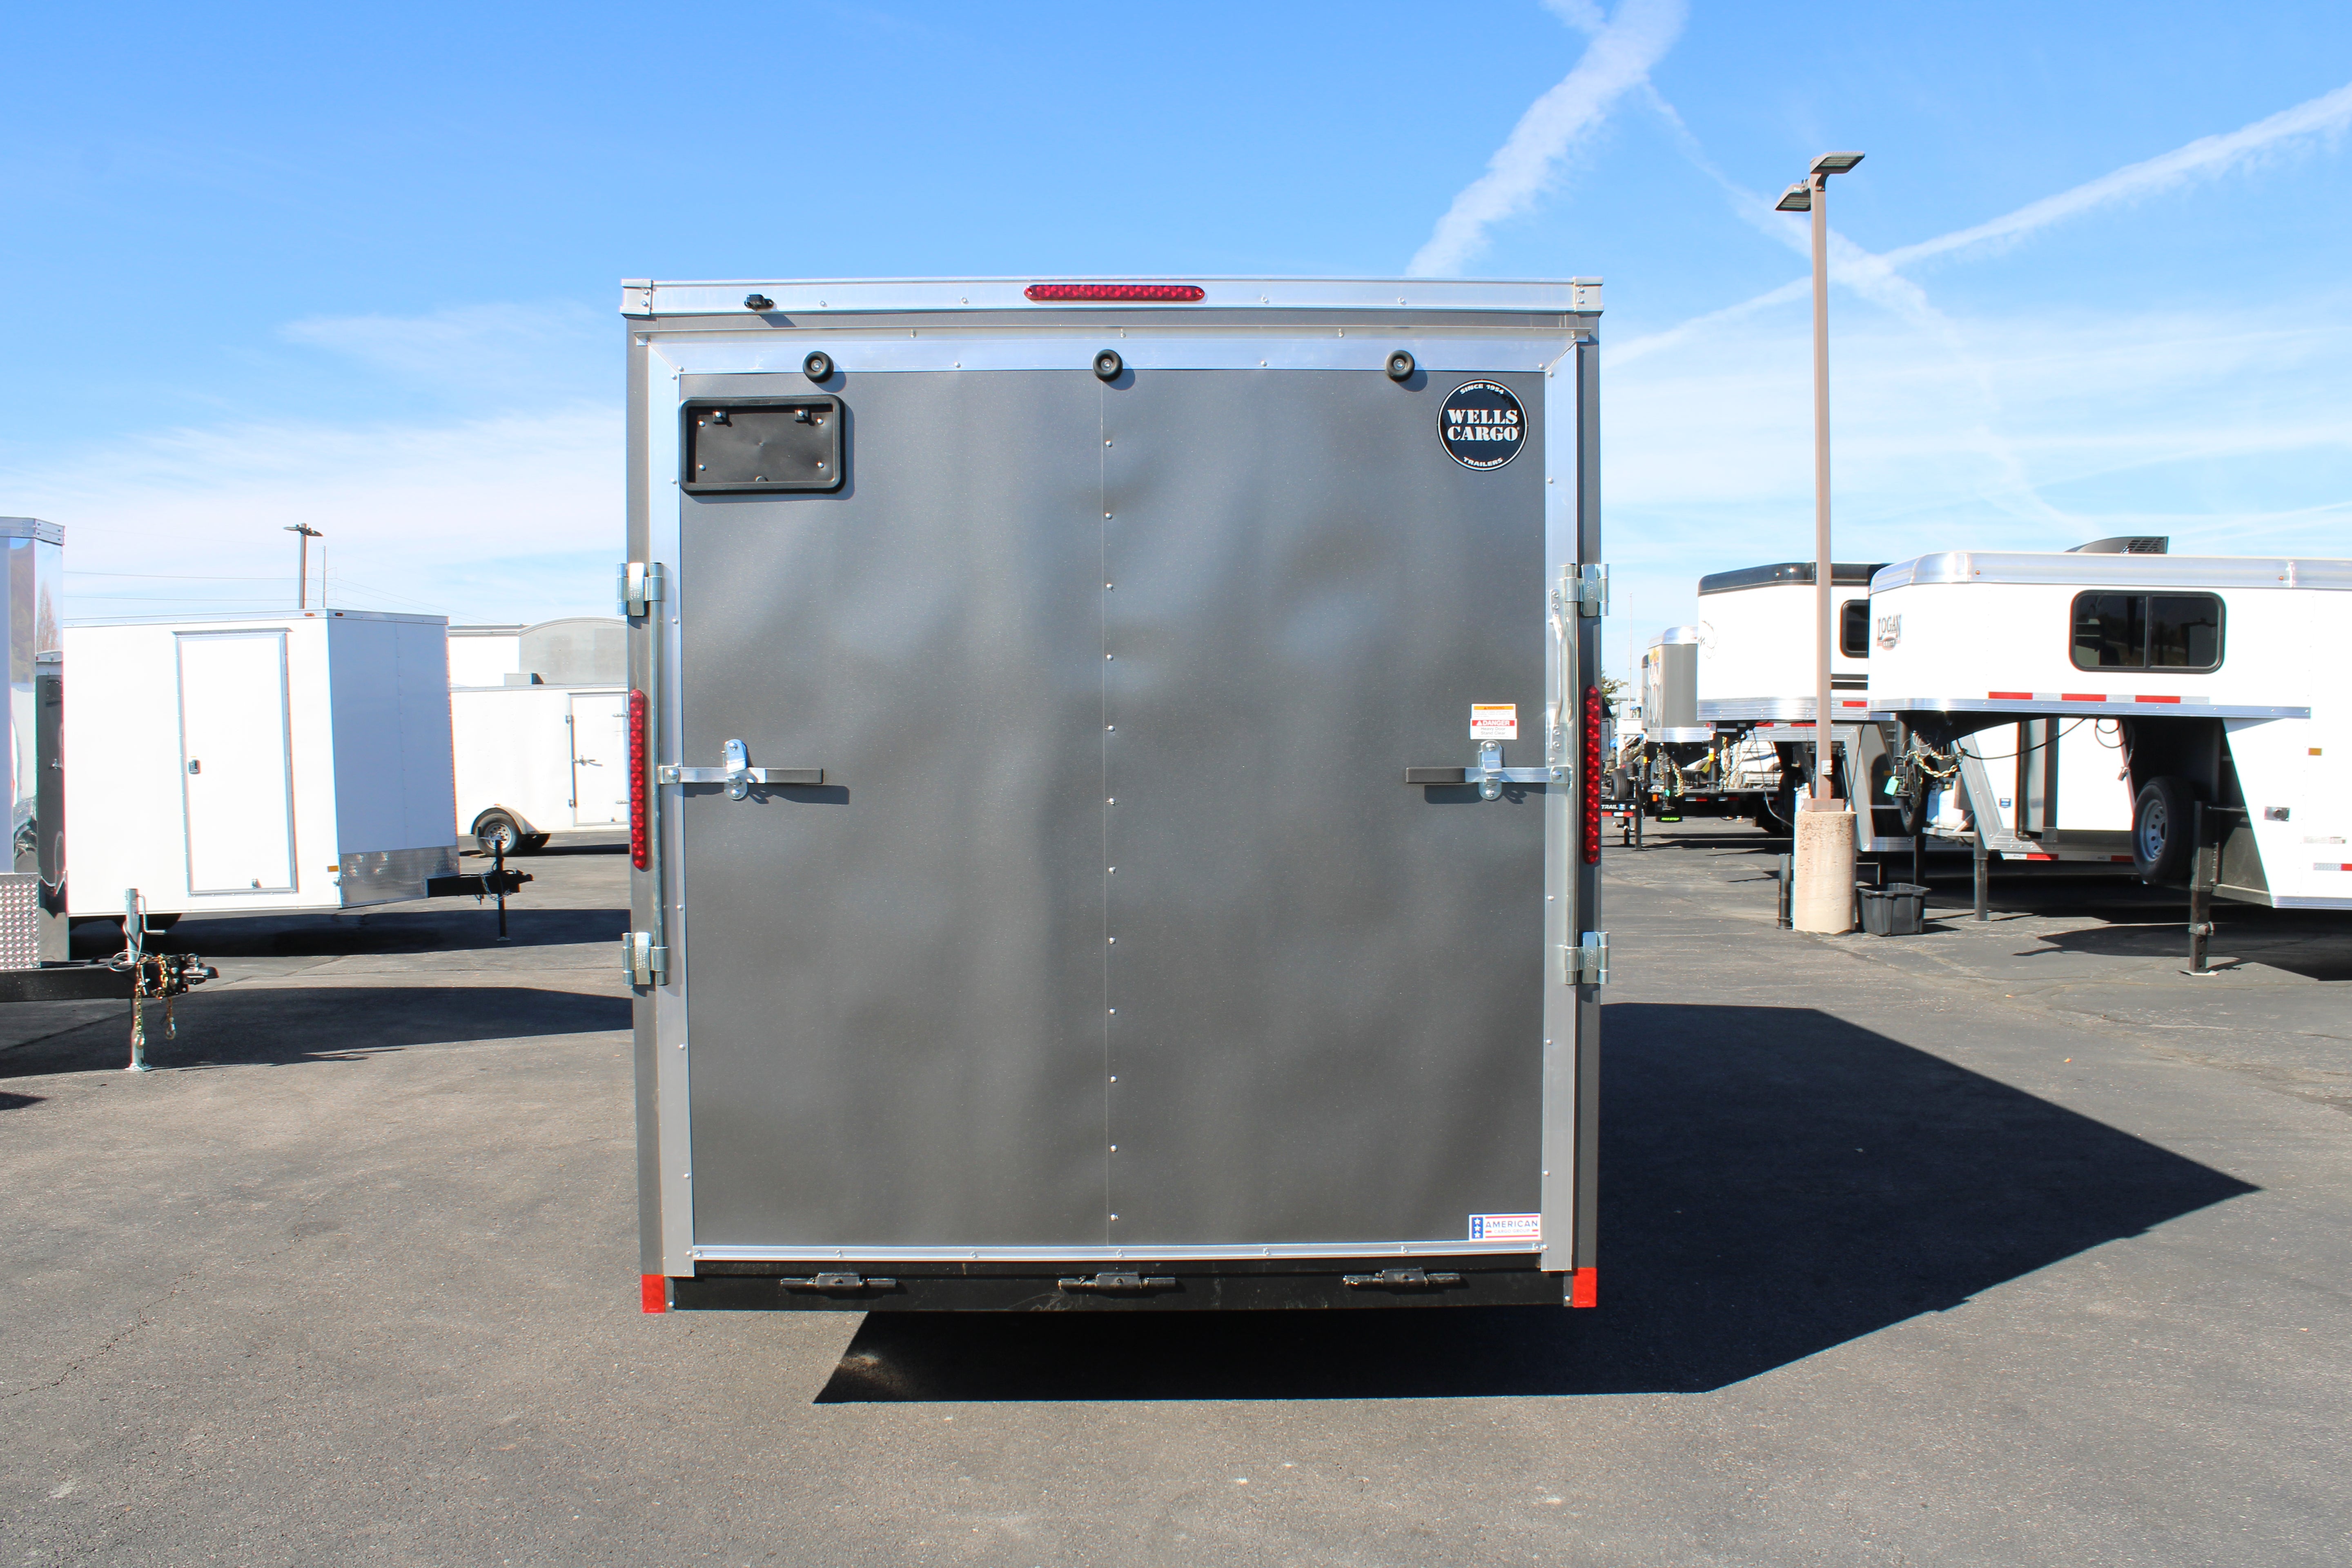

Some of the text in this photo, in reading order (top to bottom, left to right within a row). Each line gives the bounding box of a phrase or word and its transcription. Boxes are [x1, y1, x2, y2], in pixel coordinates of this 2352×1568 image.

[1459, 383, 1505, 395] SINCE 1954
[1447, 409, 1518, 425] WELLS
[1447, 426, 1519, 441] CARGO
[1463, 457, 1503, 467] TRAILERS
[1878, 614, 1901, 641] LOGAN
